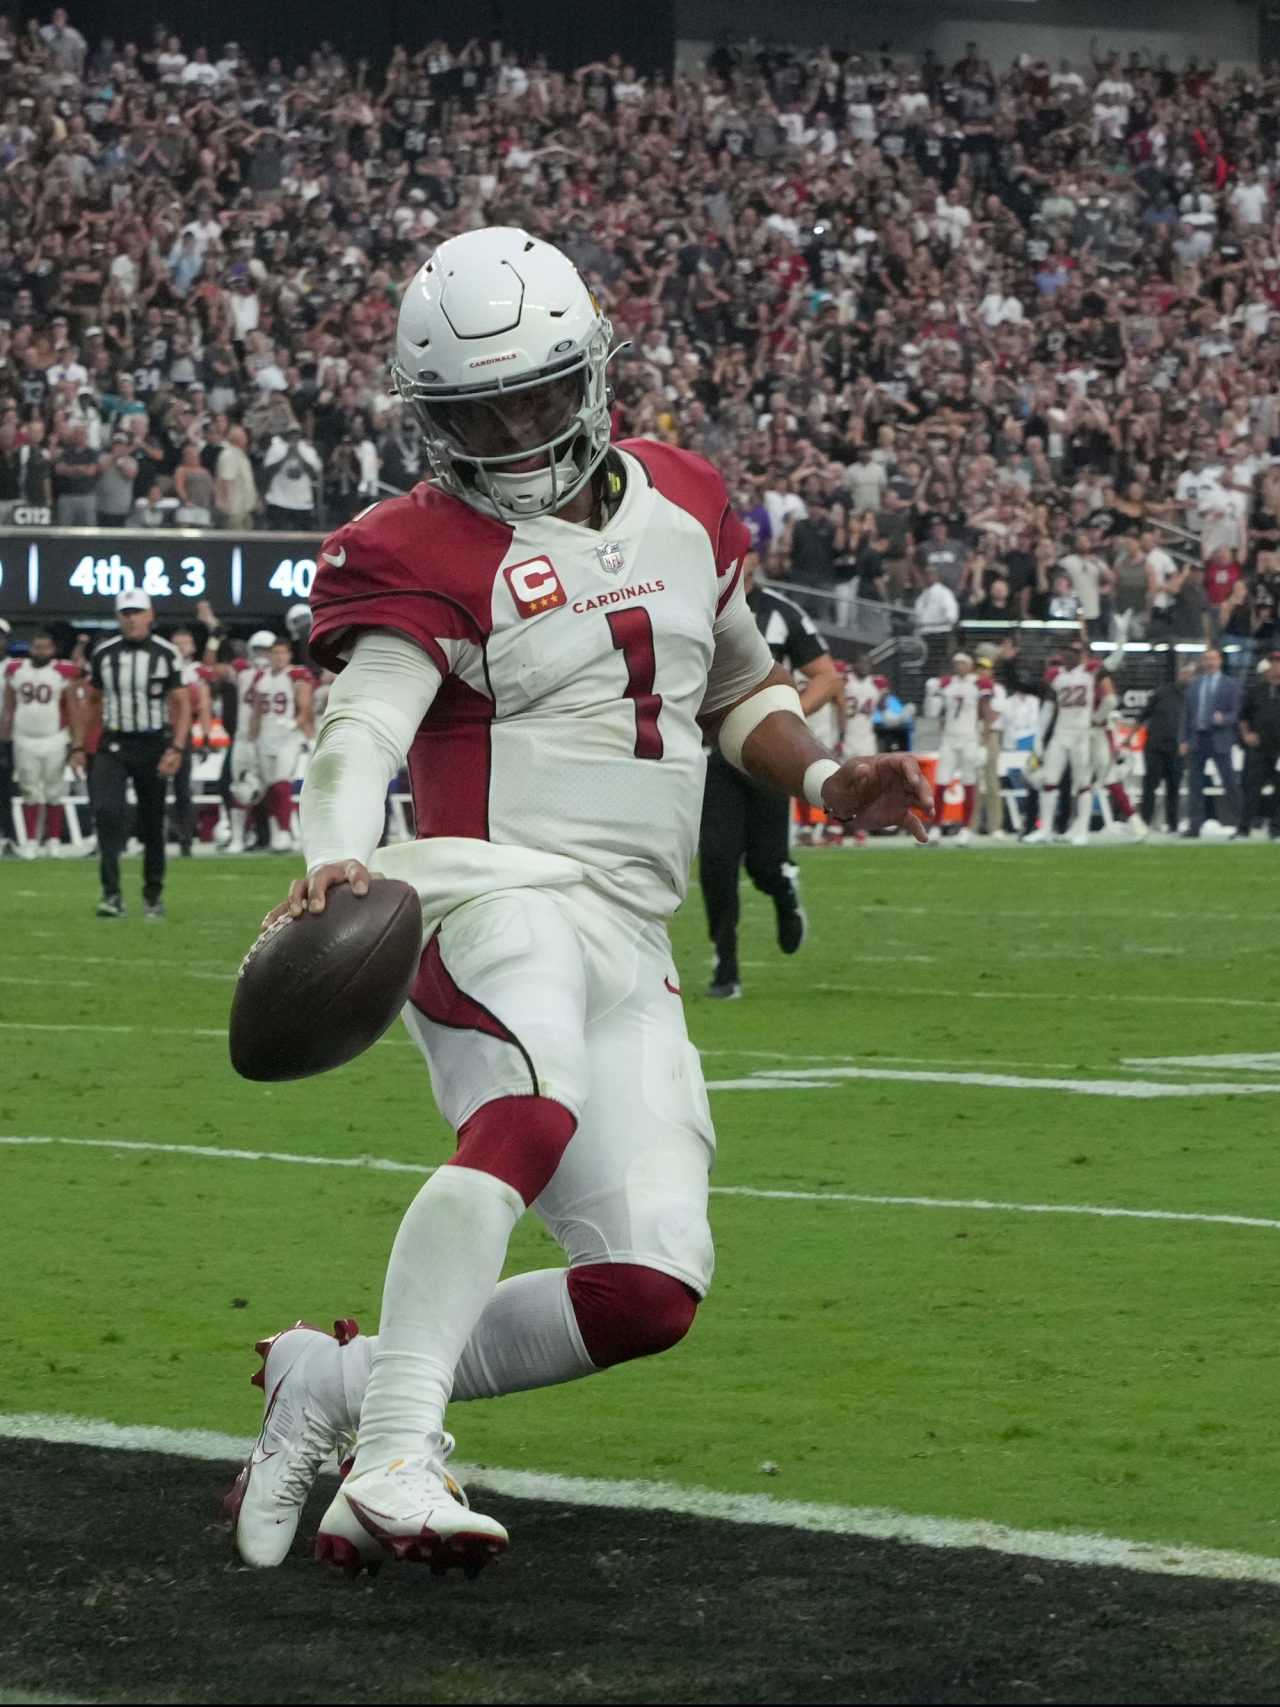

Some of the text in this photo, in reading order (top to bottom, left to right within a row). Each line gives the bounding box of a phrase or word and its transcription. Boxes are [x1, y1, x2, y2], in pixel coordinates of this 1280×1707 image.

[469, 353, 517, 368] CARDINALS
[69, 554, 206, 596] 4th & 3
[268, 559, 317, 597] 40
[510, 560, 557, 602] C
[573, 580, 665, 614] CARDINALS
[604, 605, 664, 760] 1
